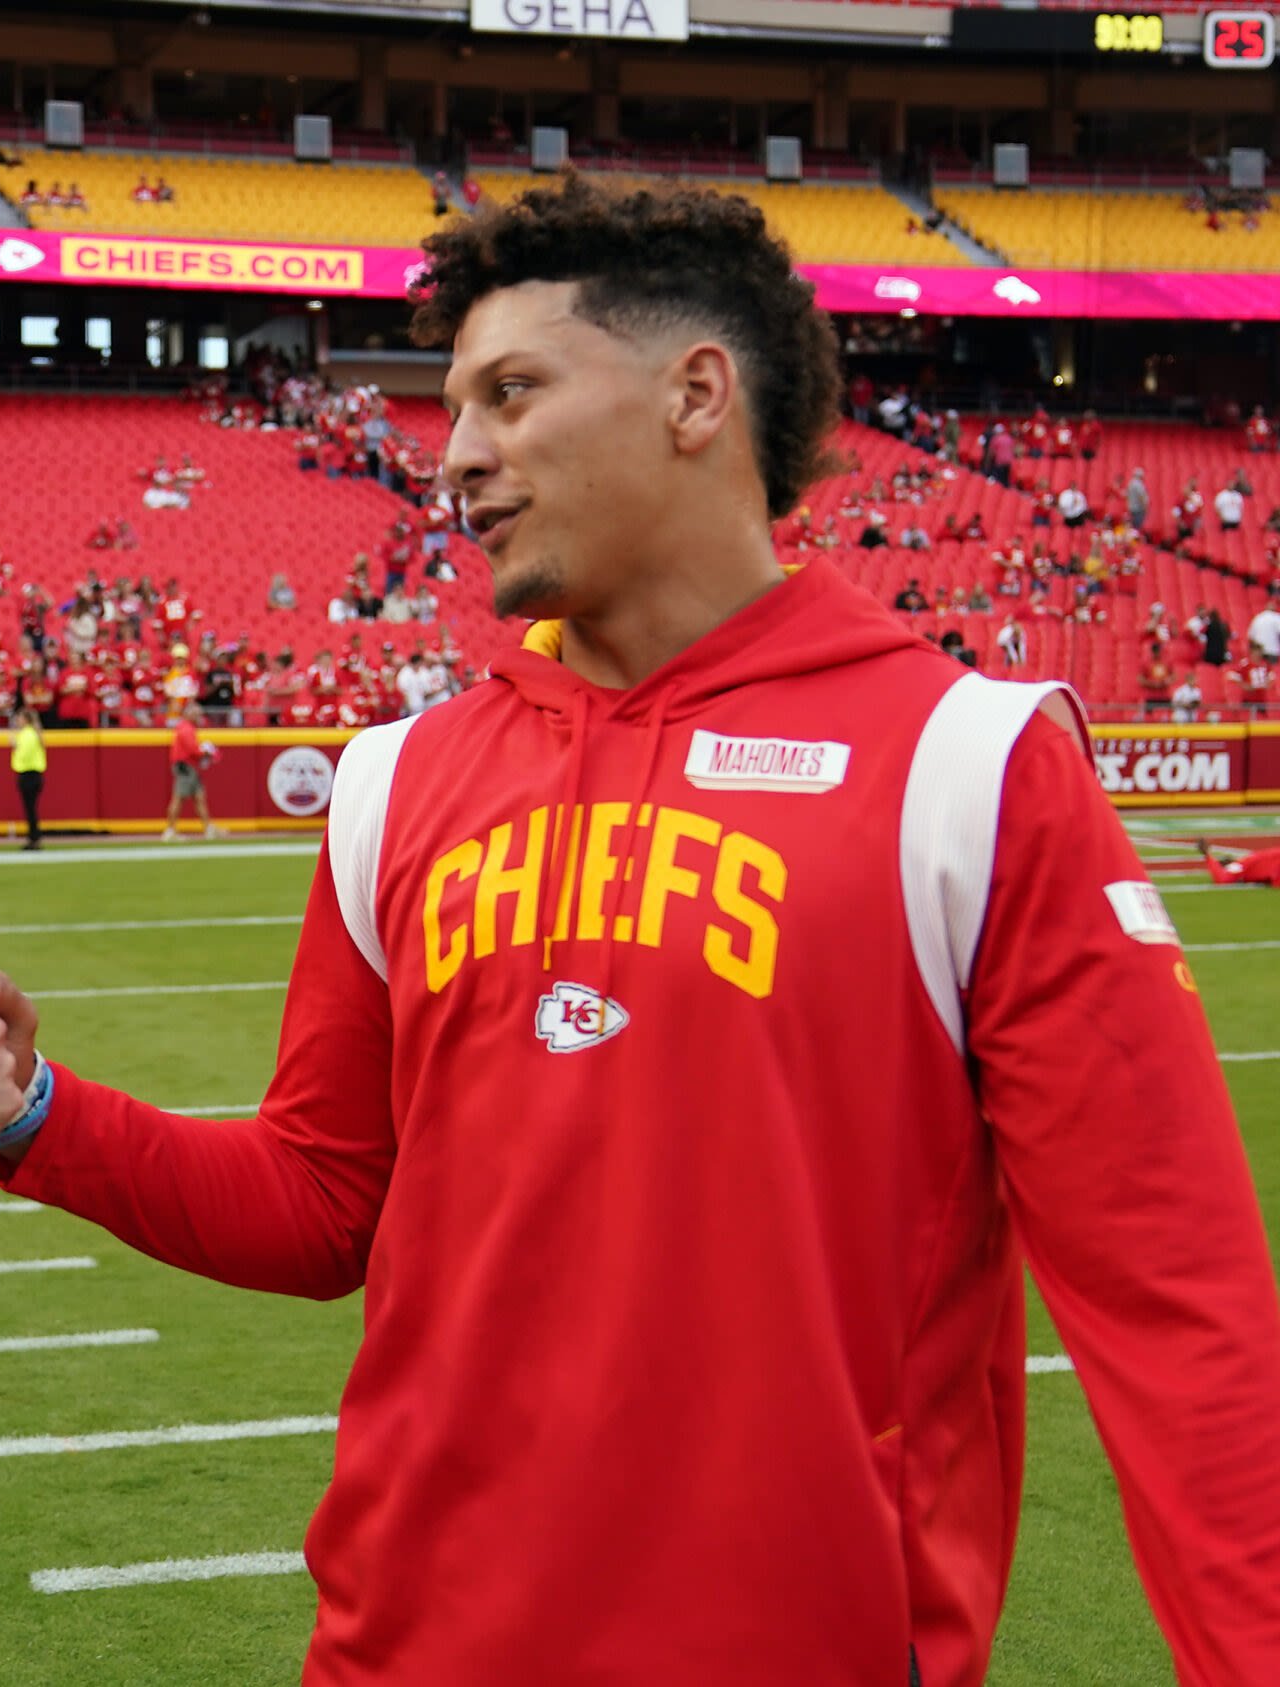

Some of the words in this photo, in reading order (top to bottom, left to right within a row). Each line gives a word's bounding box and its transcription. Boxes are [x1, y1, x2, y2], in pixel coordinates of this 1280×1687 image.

[503, 0, 655, 32] GEHA
[1214, 20, 1264, 59] 25
[76, 246, 350, 282] CHIEFS.COM
[708, 741, 824, 777] MAHOMES
[1096, 738, 1190, 752] TICKETS
[423, 802, 788, 999] CHIEFS
